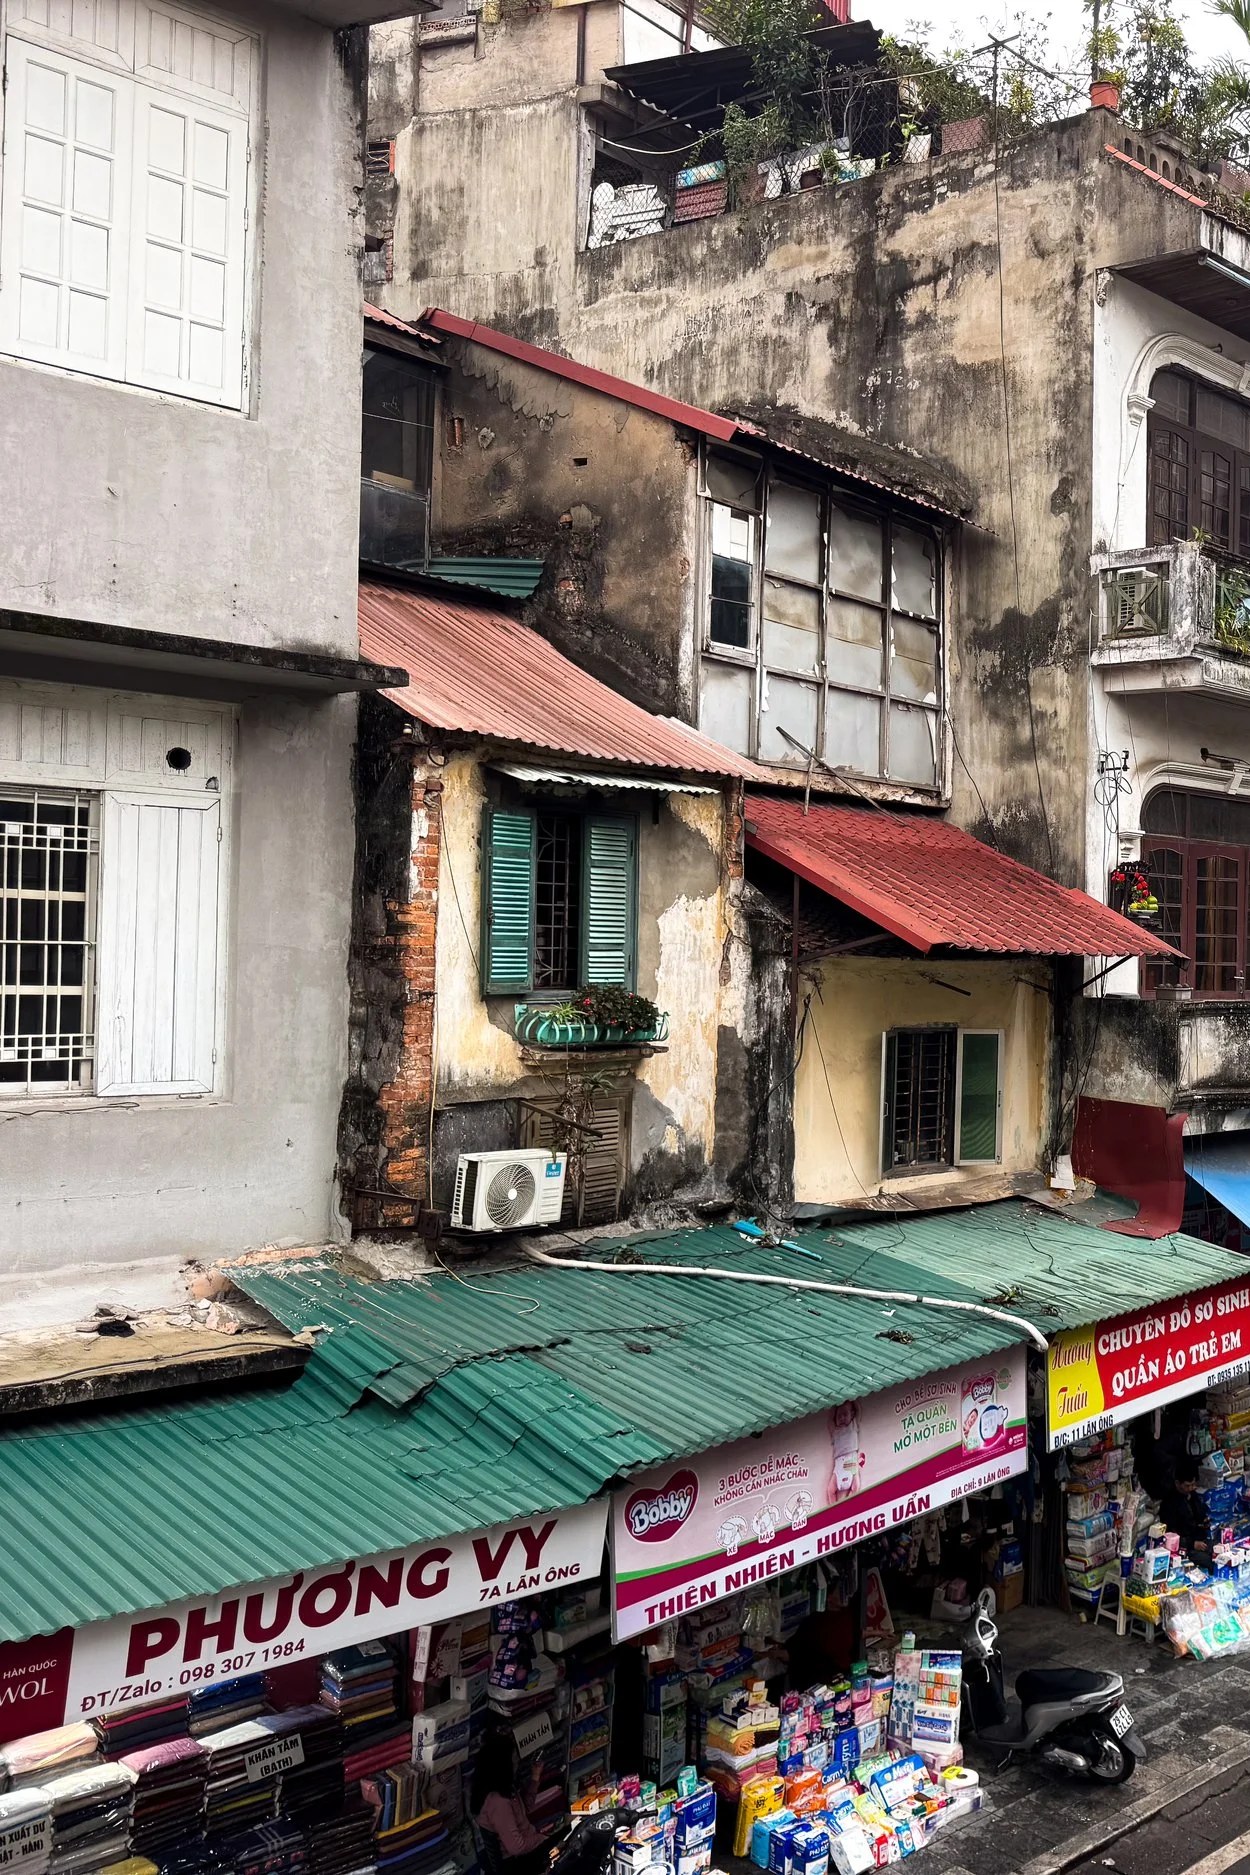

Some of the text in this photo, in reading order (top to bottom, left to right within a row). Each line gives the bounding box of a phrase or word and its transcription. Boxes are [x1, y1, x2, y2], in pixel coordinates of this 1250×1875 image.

[1099, 1288, 1250, 1356] CHUYÊN ĐỒ SƠ SINH
[1111, 1329, 1242, 1397] QUẦN ÁO TRẺ EM
[1217, 1368, 1231, 1384] 0935
[1231, 1363, 1243, 1379] 135
[894, 1394, 912, 1414] CHO
[927, 1383, 938, 1398] SƠ
[940, 1382, 957, 1396] SINH
[916, 1401, 947, 1424] QUẦN
[893, 1430, 911, 1453] MỞ
[913, 1425, 935, 1445] MỘT
[1071, 1427, 1081, 1441] 11
[1099, 1413, 1114, 1430] ÔNG
[719, 1478, 726, 1491] 3
[728, 1467, 758, 1487] BƯỚC
[760, 1456, 774, 1475] DỄ
[776, 1453, 799, 1471] MẶC
[951, 1483, 963, 1499] ĐỊA
[997, 1466, 1011, 1480] ÔNG
[632, 1487, 694, 1536] Bobby
[714, 1488, 744, 1507] KHÔNG
[479, 1562, 580, 1601] 7A LÃN ÔNG
[645, 1580, 717, 1625] THIÊN
[725, 1549, 795, 1593] NHIÊN
[817, 1511, 886, 1555] HƯƠNG
[124, 1519, 558, 1678] PHƯƠNG VY
[3, 1658, 58, 1680] HÀN QUỐC
[80, 1677, 163, 1712] ĐT/Zalo
[179, 1662, 215, 1686] 098
[220, 1652, 256, 1676] 307
[262, 1638, 306, 1662] 1984
[260, 1756, 293, 1777] (BATH)
[8, 1825, 31, 1845] XUẤT
[33, 1820, 46, 1836] DƯ
